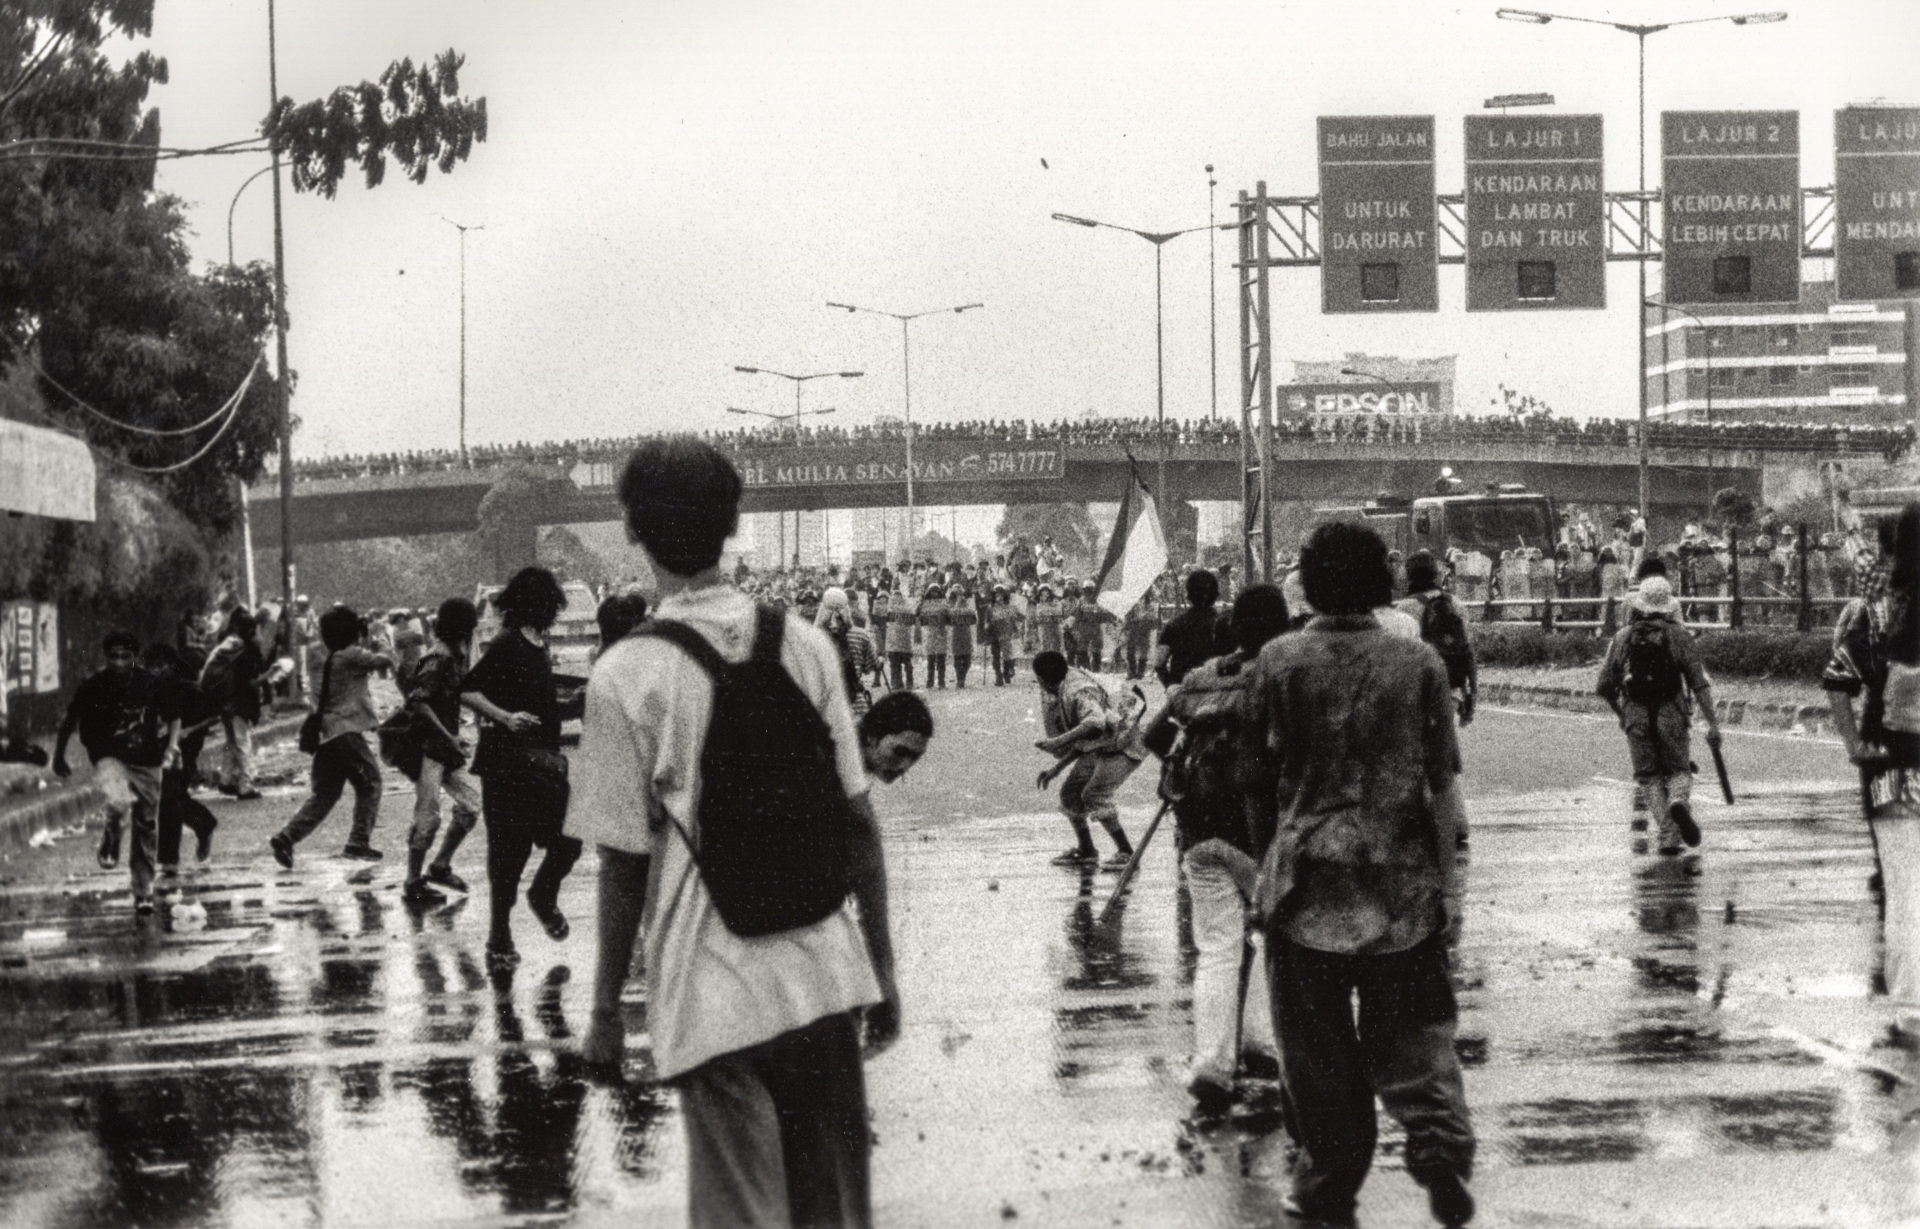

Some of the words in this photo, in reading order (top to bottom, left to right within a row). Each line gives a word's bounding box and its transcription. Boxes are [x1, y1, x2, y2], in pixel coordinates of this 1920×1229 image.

[1377, 131, 1428, 147] JALAN
[1487, 129, 1563, 148] LAJUR
[1682, 125, 1758, 143] LAJUR
[1767, 125, 1780, 142] 2
[1473, 174, 1598, 193] KENDARAAN
[1344, 201, 1412, 219] UNTUK
[1494, 202, 1576, 221] LAMBAT
[1671, 194, 1792, 213] KENDARAAN
[1332, 230, 1426, 249] DARURAT
[1481, 230, 1523, 248] DAN
[1537, 229, 1590, 247] TRUK
[1671, 224, 1728, 243] LEBIH
[1733, 223, 1790, 242] CEPAT
[1846, 221, 1920, 240] MENDA
[776, 464, 848, 484] MULIA
